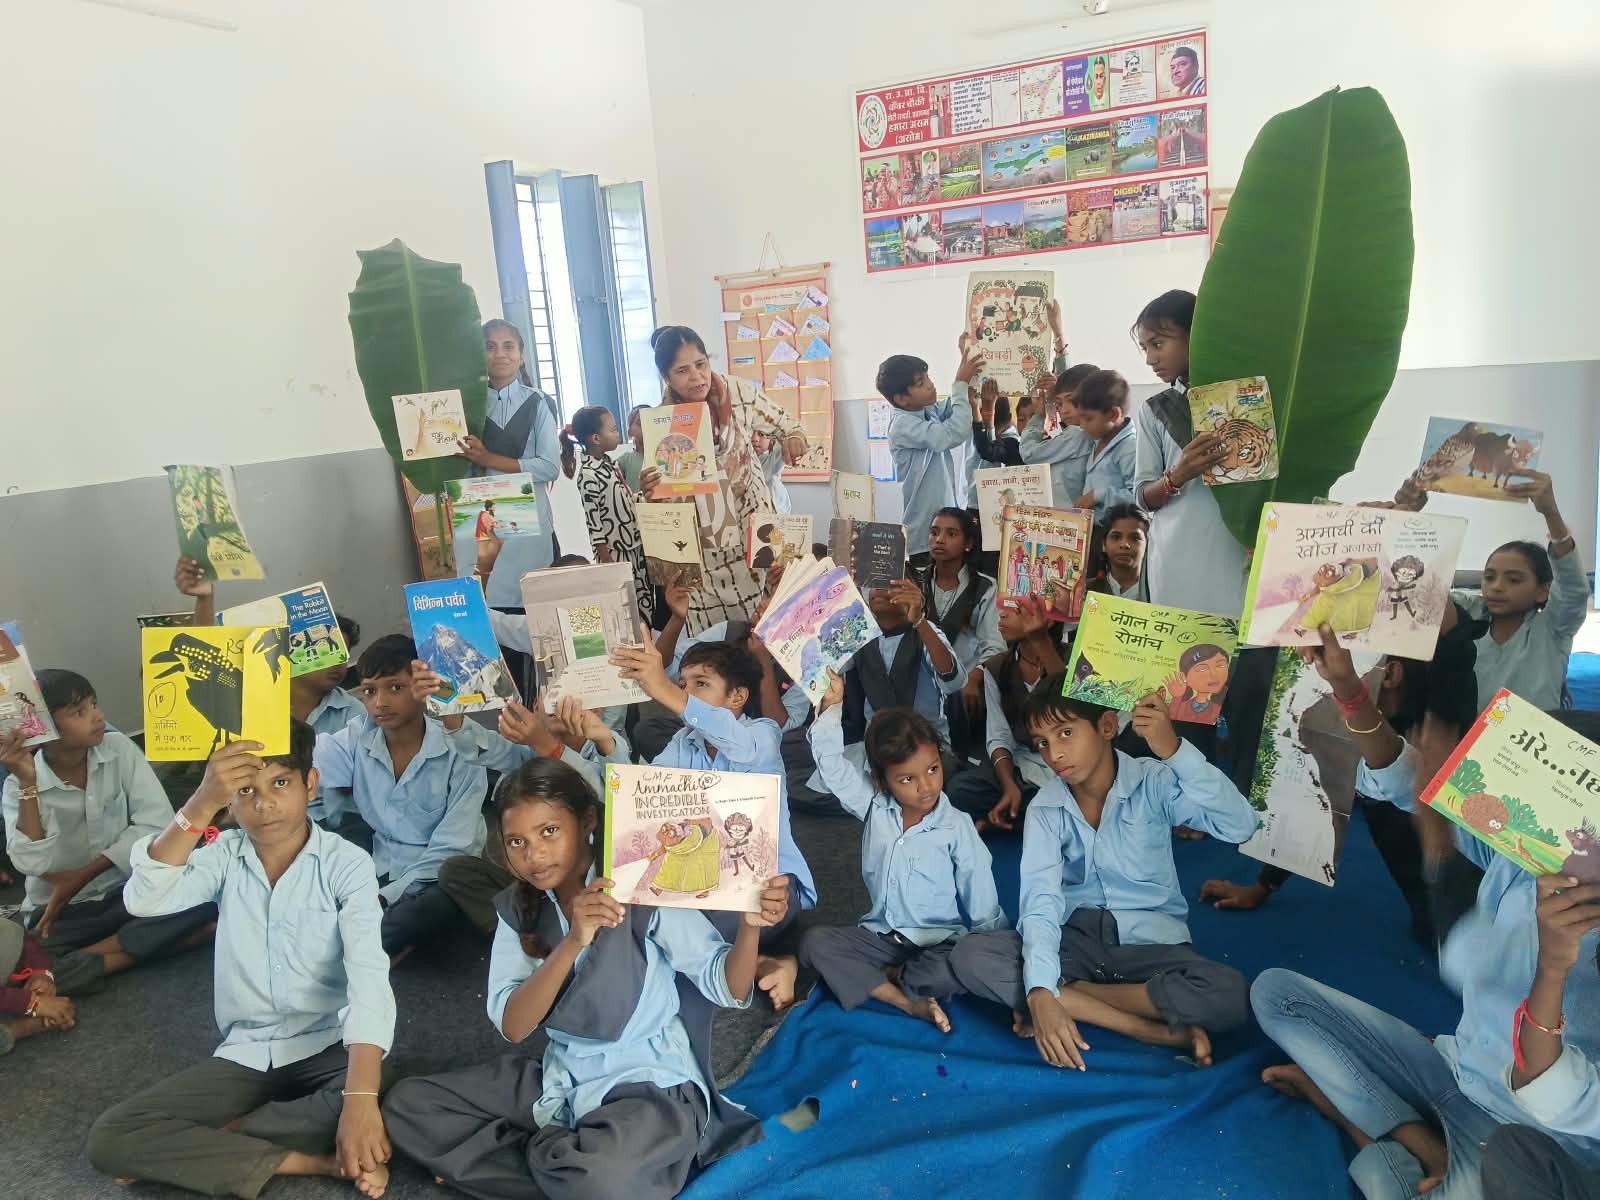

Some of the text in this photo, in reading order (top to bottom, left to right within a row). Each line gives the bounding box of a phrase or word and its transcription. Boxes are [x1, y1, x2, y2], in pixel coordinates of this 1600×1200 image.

[1296, 518, 1354, 543] अम्माची
[1295, 541, 1338, 559] खोज
[290, 604, 304, 613] The
[412, 591, 467, 611] विभिन्न पर्वत
[297, 610, 308, 618] the
[308, 606, 329, 616] Moon
[1110, 610, 1178, 636] जंगल का
[1114, 627, 1164, 651] रोमांच
[1567, 740, 1598, 757] CMF
[642, 772, 673, 782] CMF
[634, 793, 708, 810] INCREDIBLE
[636, 806, 710, 820] INVESTIGATION
